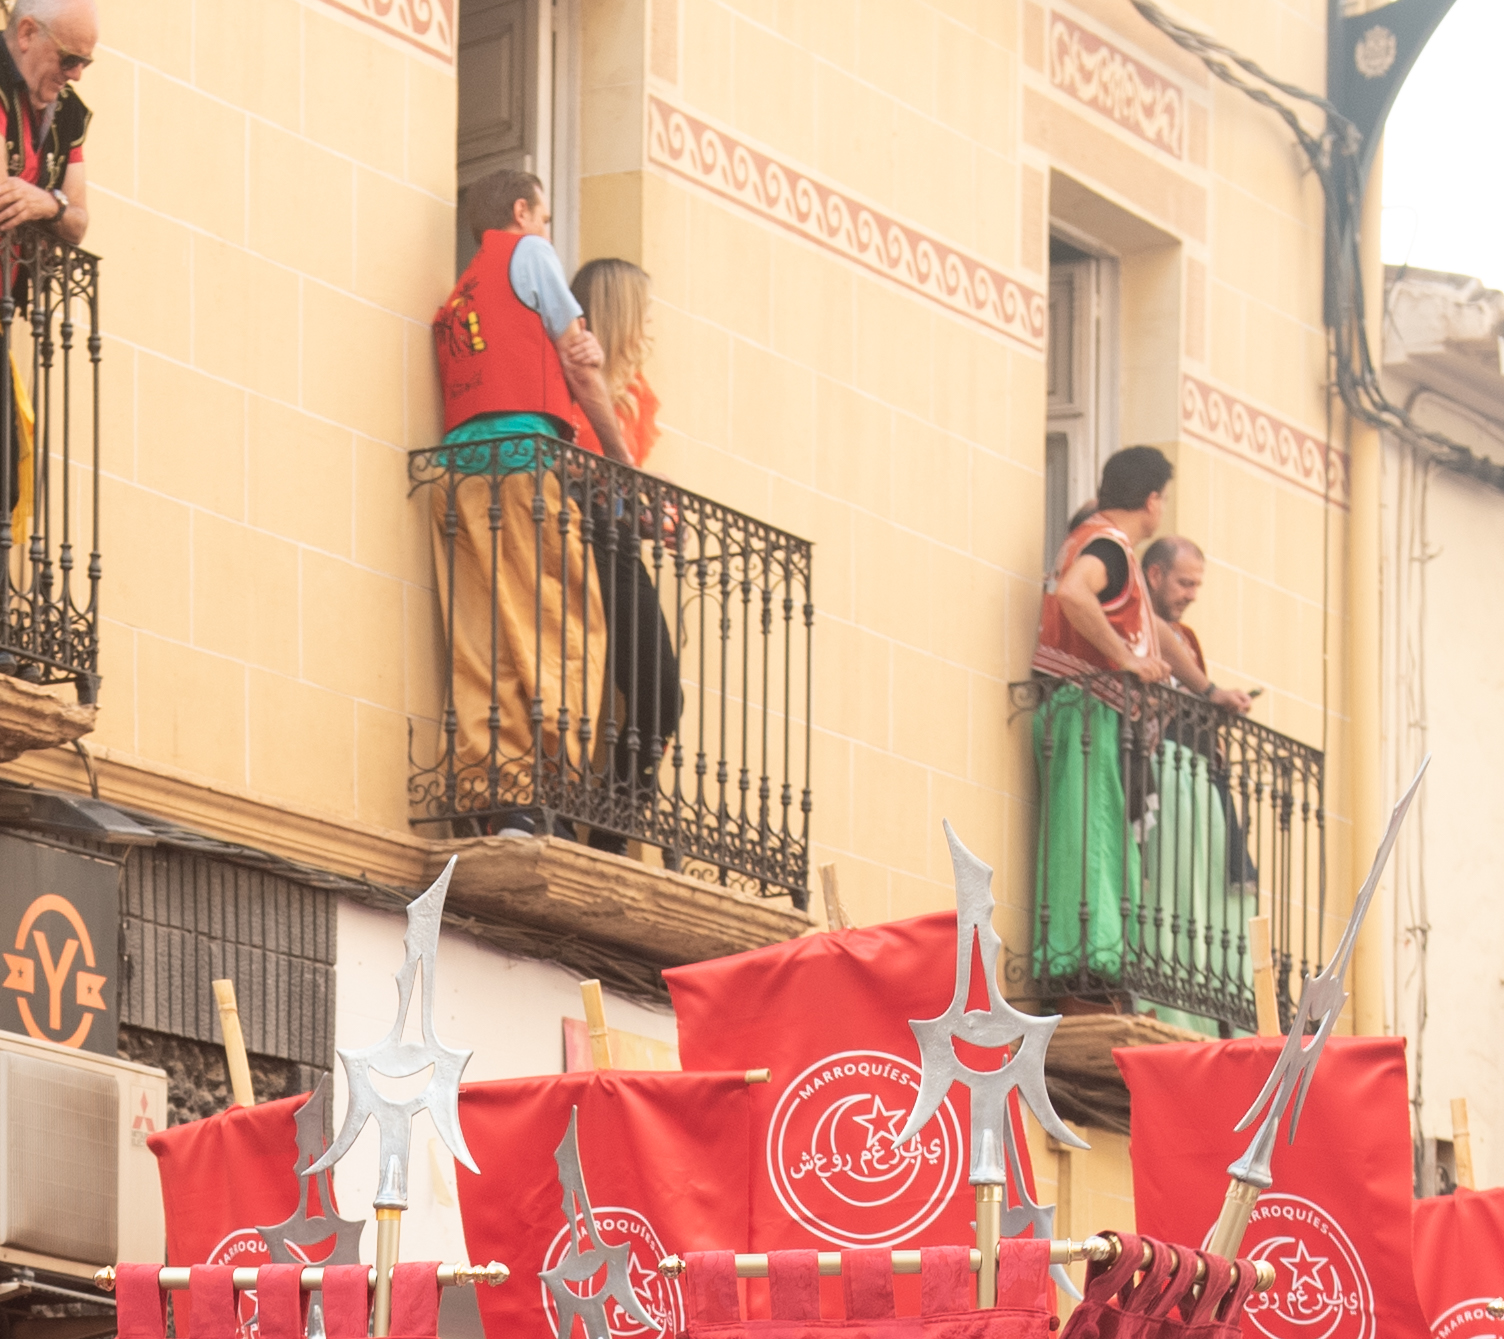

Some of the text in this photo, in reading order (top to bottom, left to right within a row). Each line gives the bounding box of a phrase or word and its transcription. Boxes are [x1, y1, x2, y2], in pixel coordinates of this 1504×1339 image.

[33, 930, 79, 1030] Y
[798, 1061, 911, 1101] MARROQUÍES
[576, 1218, 656, 1251] AROQUÍES
[1248, 1205, 1330, 1235] RROQUÍES
